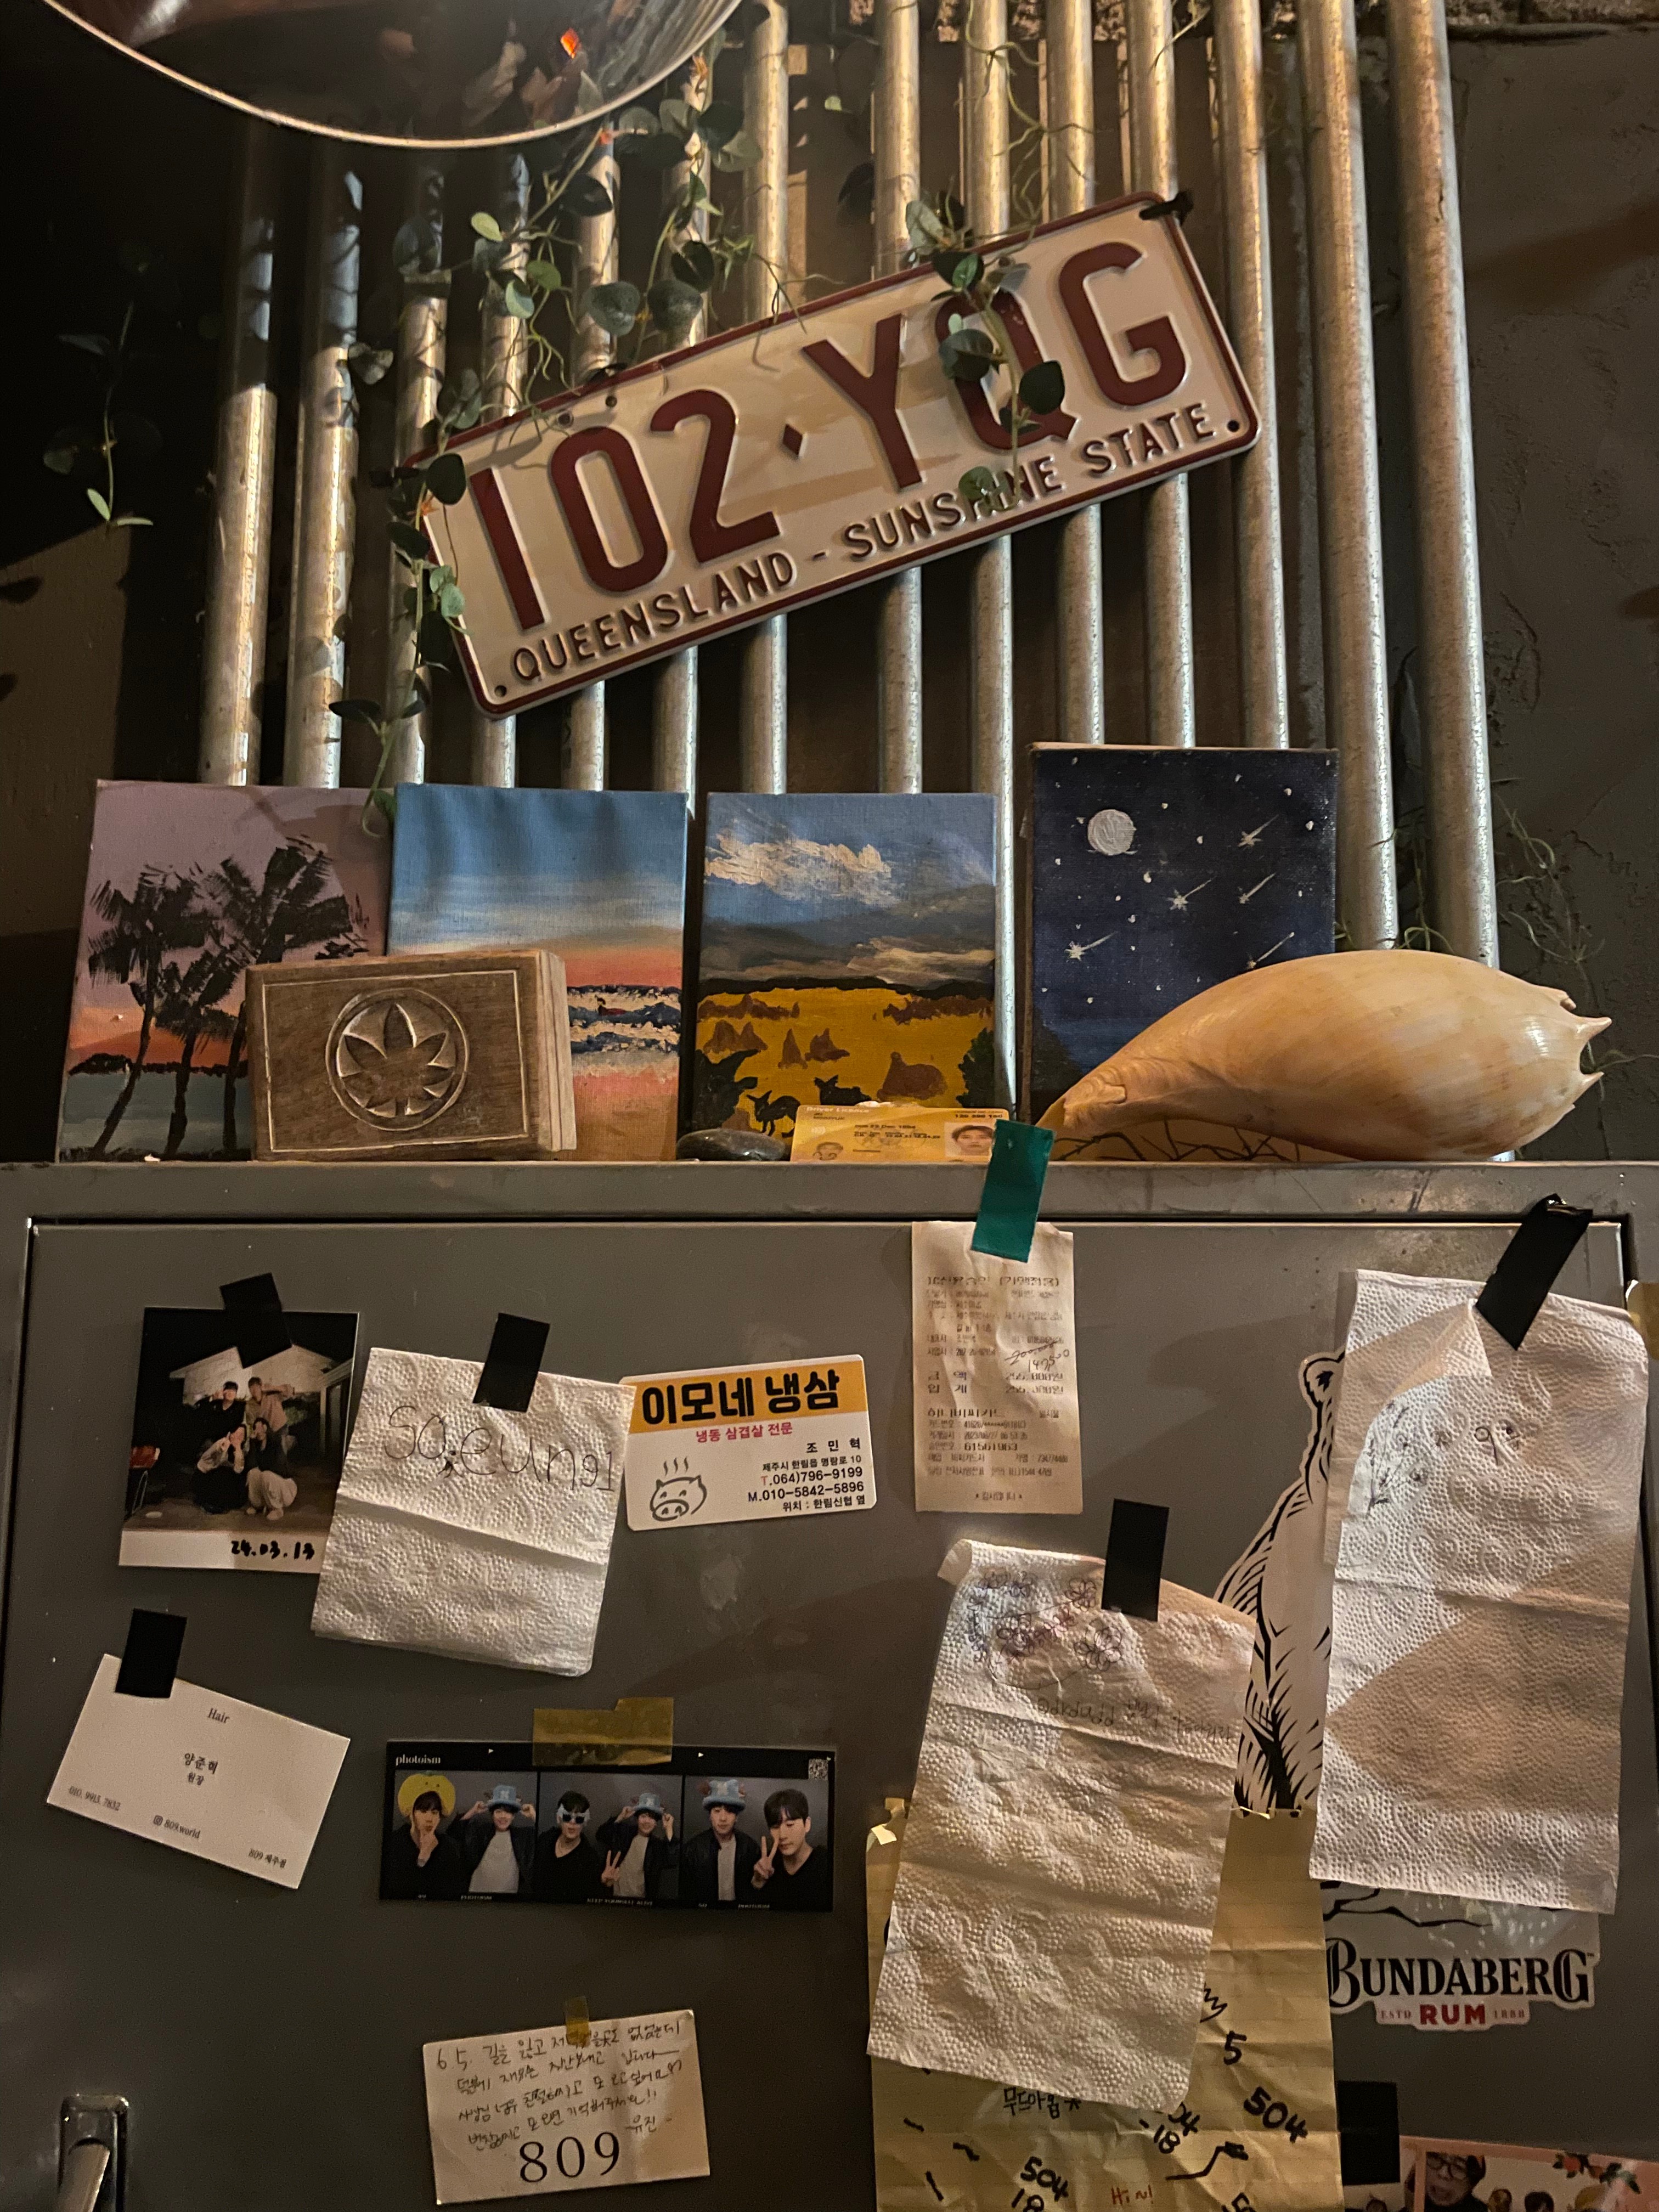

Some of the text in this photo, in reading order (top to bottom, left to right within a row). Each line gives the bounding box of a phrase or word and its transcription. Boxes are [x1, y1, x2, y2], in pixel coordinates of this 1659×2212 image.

[512, 551, 795, 682] QUEENSLAND
[1082, 402, 1216, 475] STATE
[642, 1369, 840, 1425] 이모네 냉삼
[696, 1422, 793, 1443] 냉동 삼겹살 전문
[763, 1461, 789, 1471] 제주시
[792, 1458, 818, 1469] 한림읍
[851, 1454, 862, 1464] 10
[761, 1466, 863, 1486] T.064)796-9199
[748, 1481, 864, 1503] M.010-5842-5896
[207, 1707, 230, 1724] Hair
[396, 1753, 441, 1766] photoism
[1325, 1937, 1589, 2008] BUNDABERG
[1419, 2004, 1486, 2025] RUM
[1243, 2086, 1308, 2144] 504
[519, 2131, 620, 2183] 809
[1020, 2156, 1070, 2202] 504
